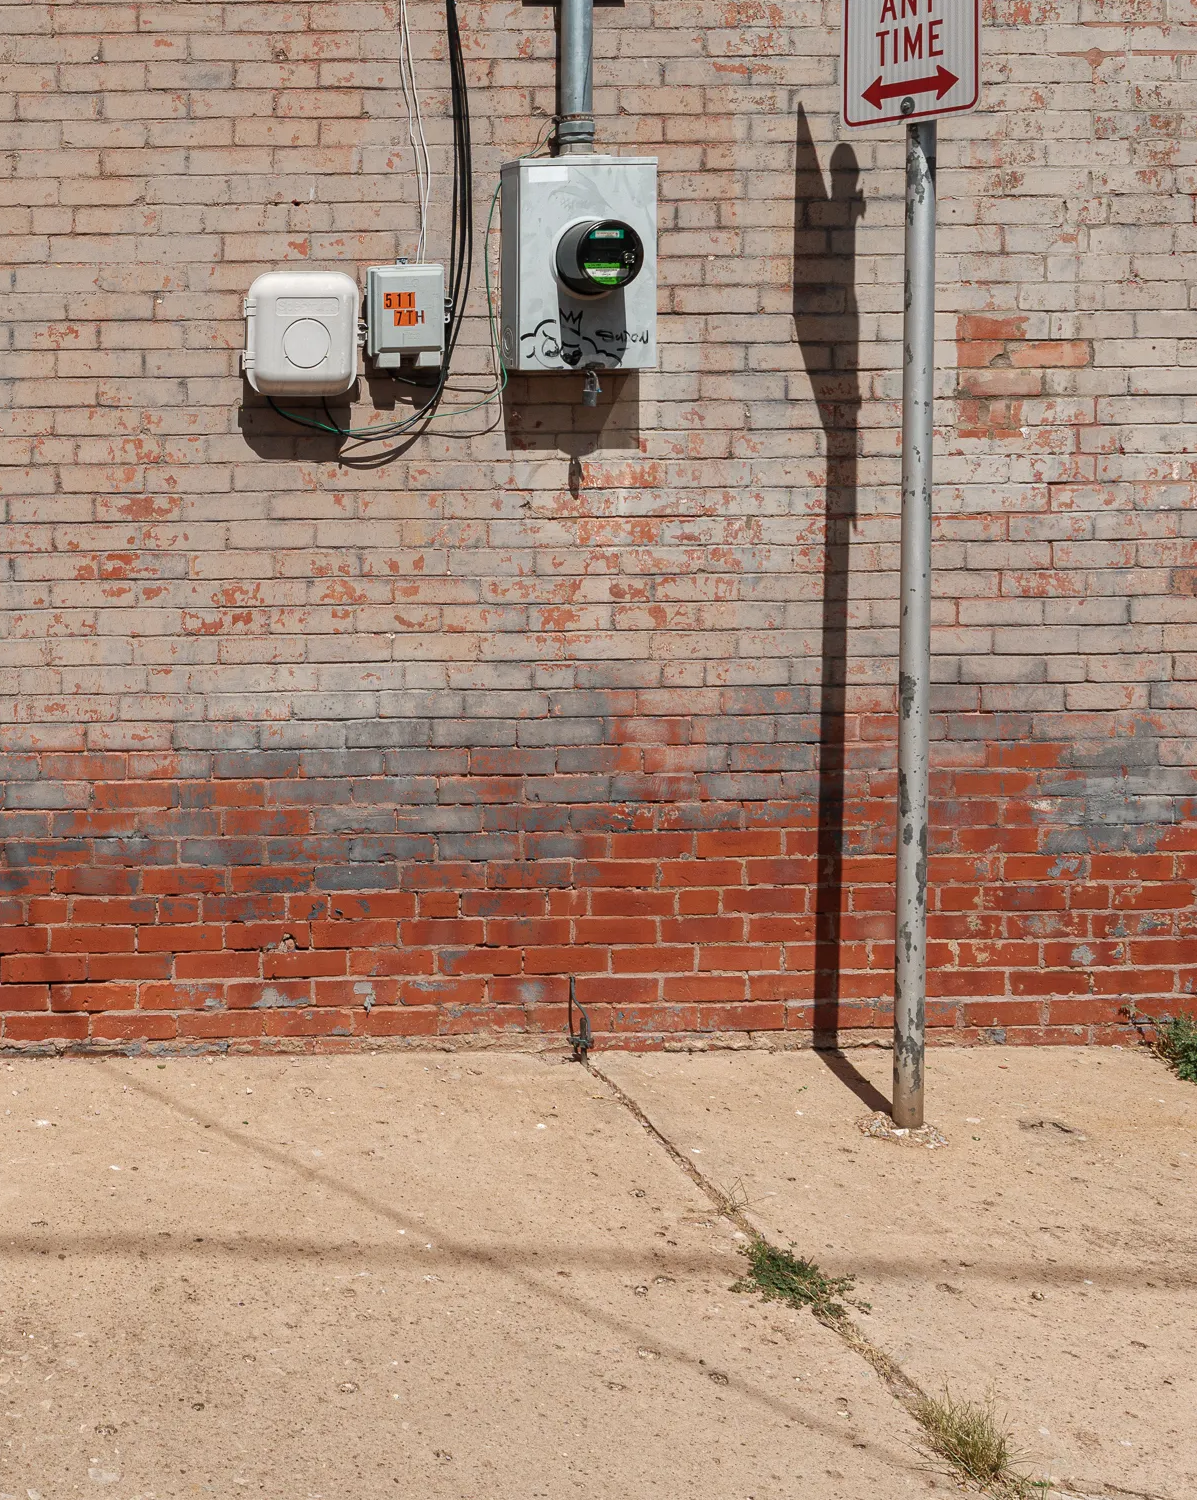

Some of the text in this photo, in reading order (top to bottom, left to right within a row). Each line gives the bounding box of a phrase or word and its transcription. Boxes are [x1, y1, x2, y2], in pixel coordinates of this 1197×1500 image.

[875, 18, 944, 67] TIME
[385, 292, 412, 308] 511
[396, 309, 425, 326] 7TH
